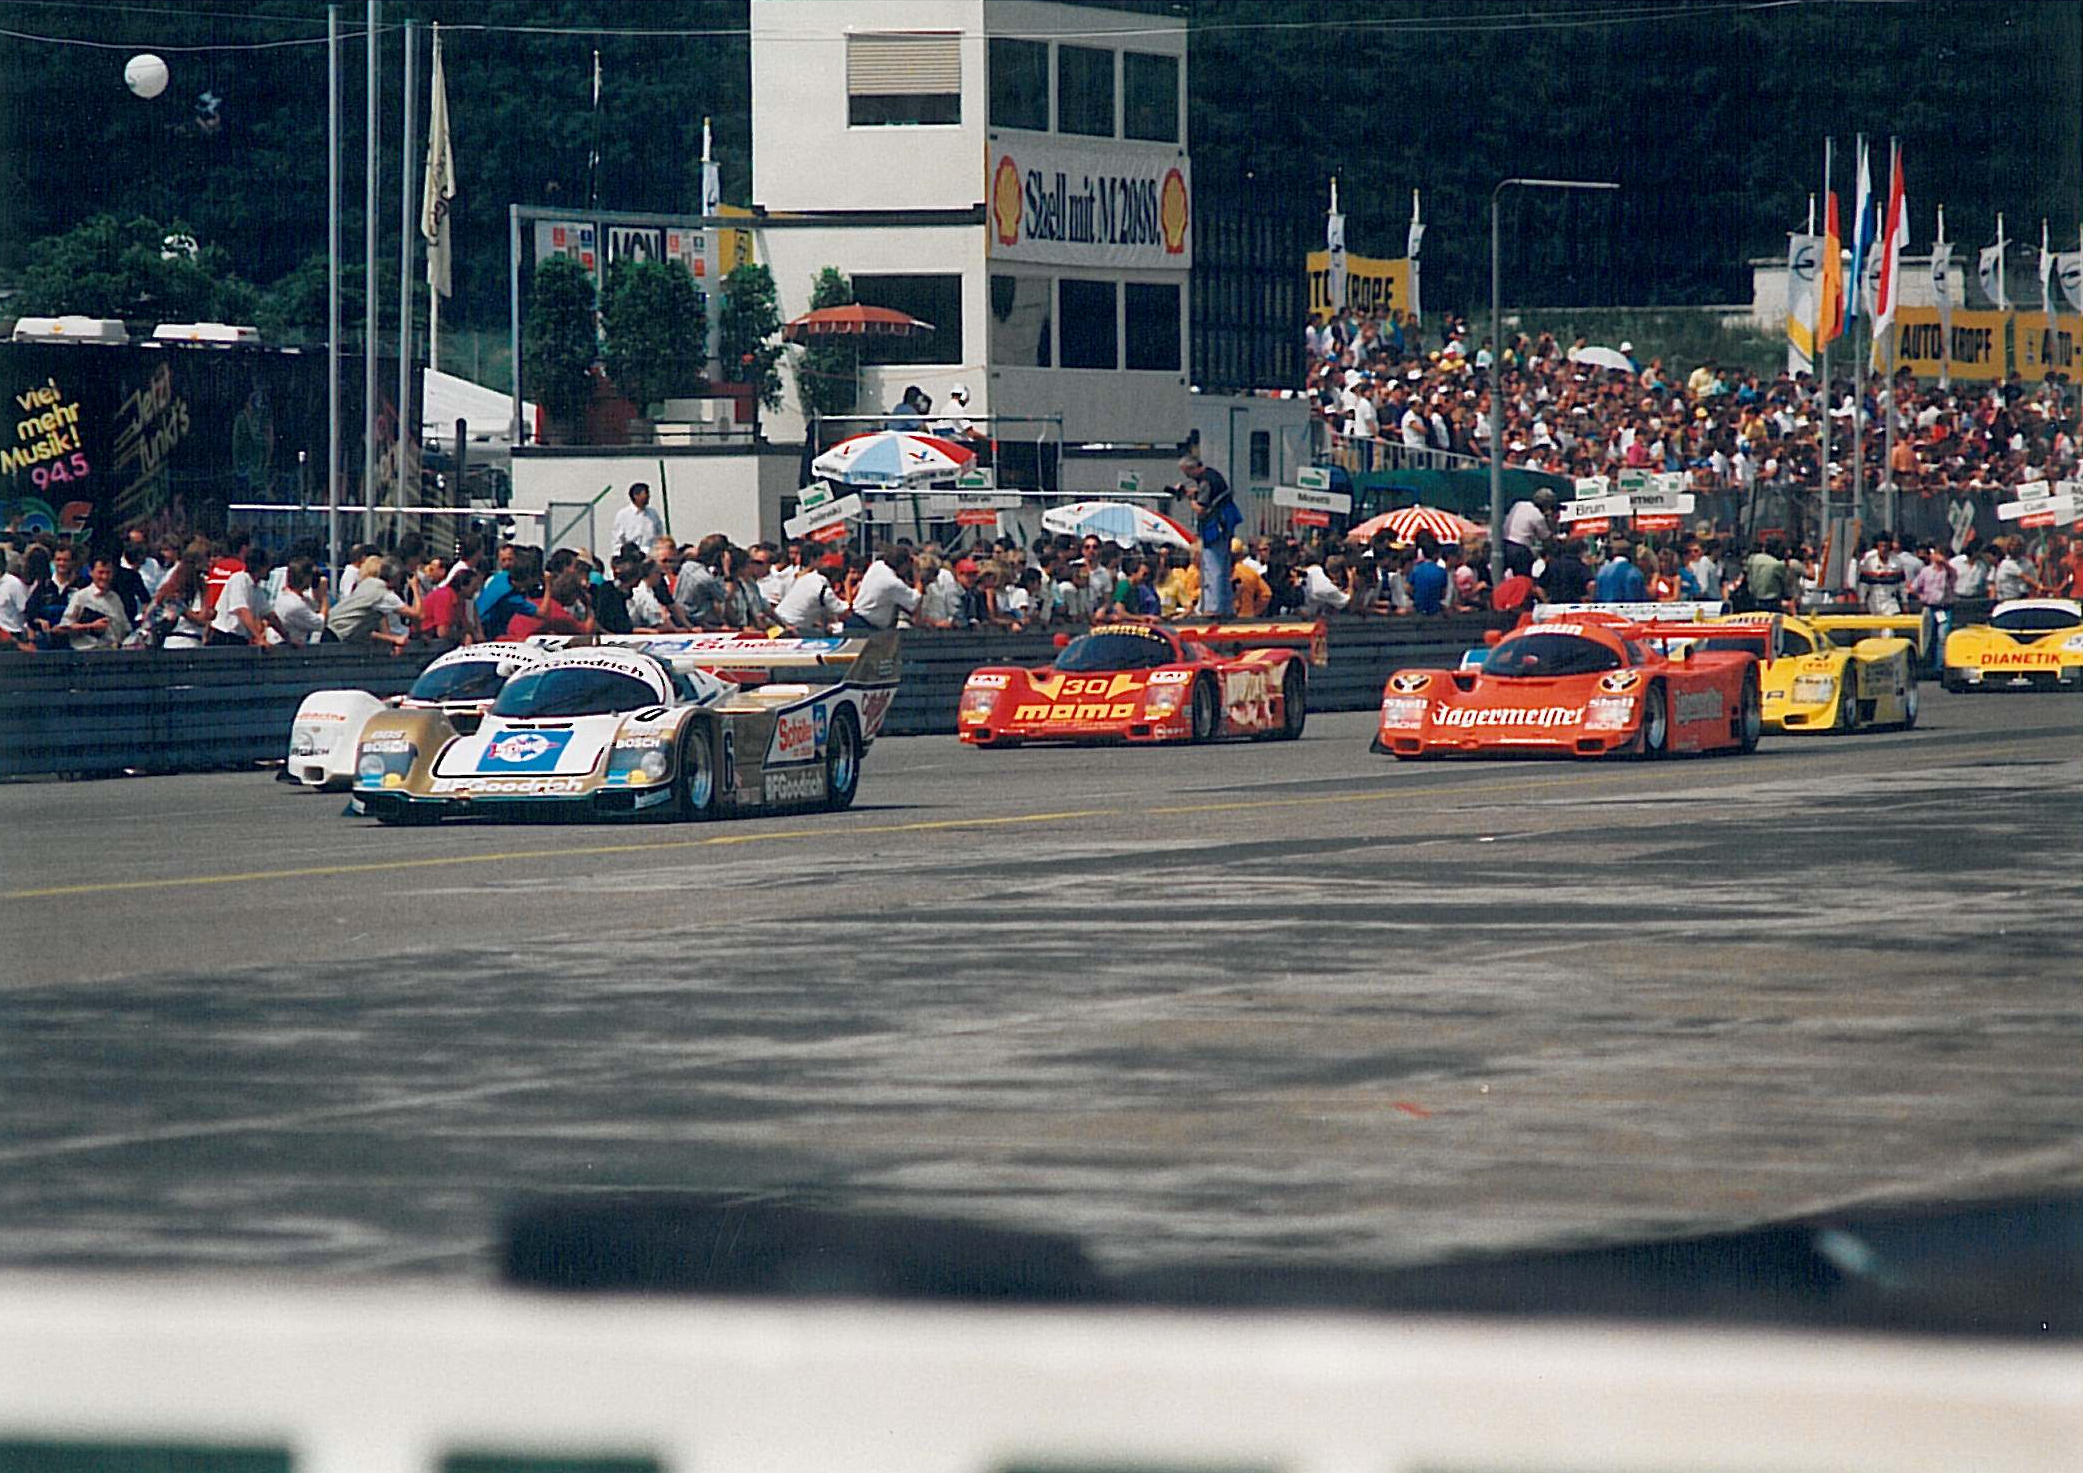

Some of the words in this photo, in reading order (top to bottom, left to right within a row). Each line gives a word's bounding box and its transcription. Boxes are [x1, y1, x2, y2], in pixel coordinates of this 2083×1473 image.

[1026, 169, 1066, 241] Shell
[1069, 176, 1095, 244] mit
[1900, 323, 1943, 360] AUTO
[16, 377, 62, 412] viel
[17, 402, 79, 441] mehr
[31, 452, 90, 491] 94.5
[1981, 653, 2061, 665] DIANETIK
[1062, 679, 1108, 695] 30
[1014, 703, 1136, 720] momo
[1432, 700, 1584, 728] Jägermeister
[616, 739, 661, 749] BOSCH
